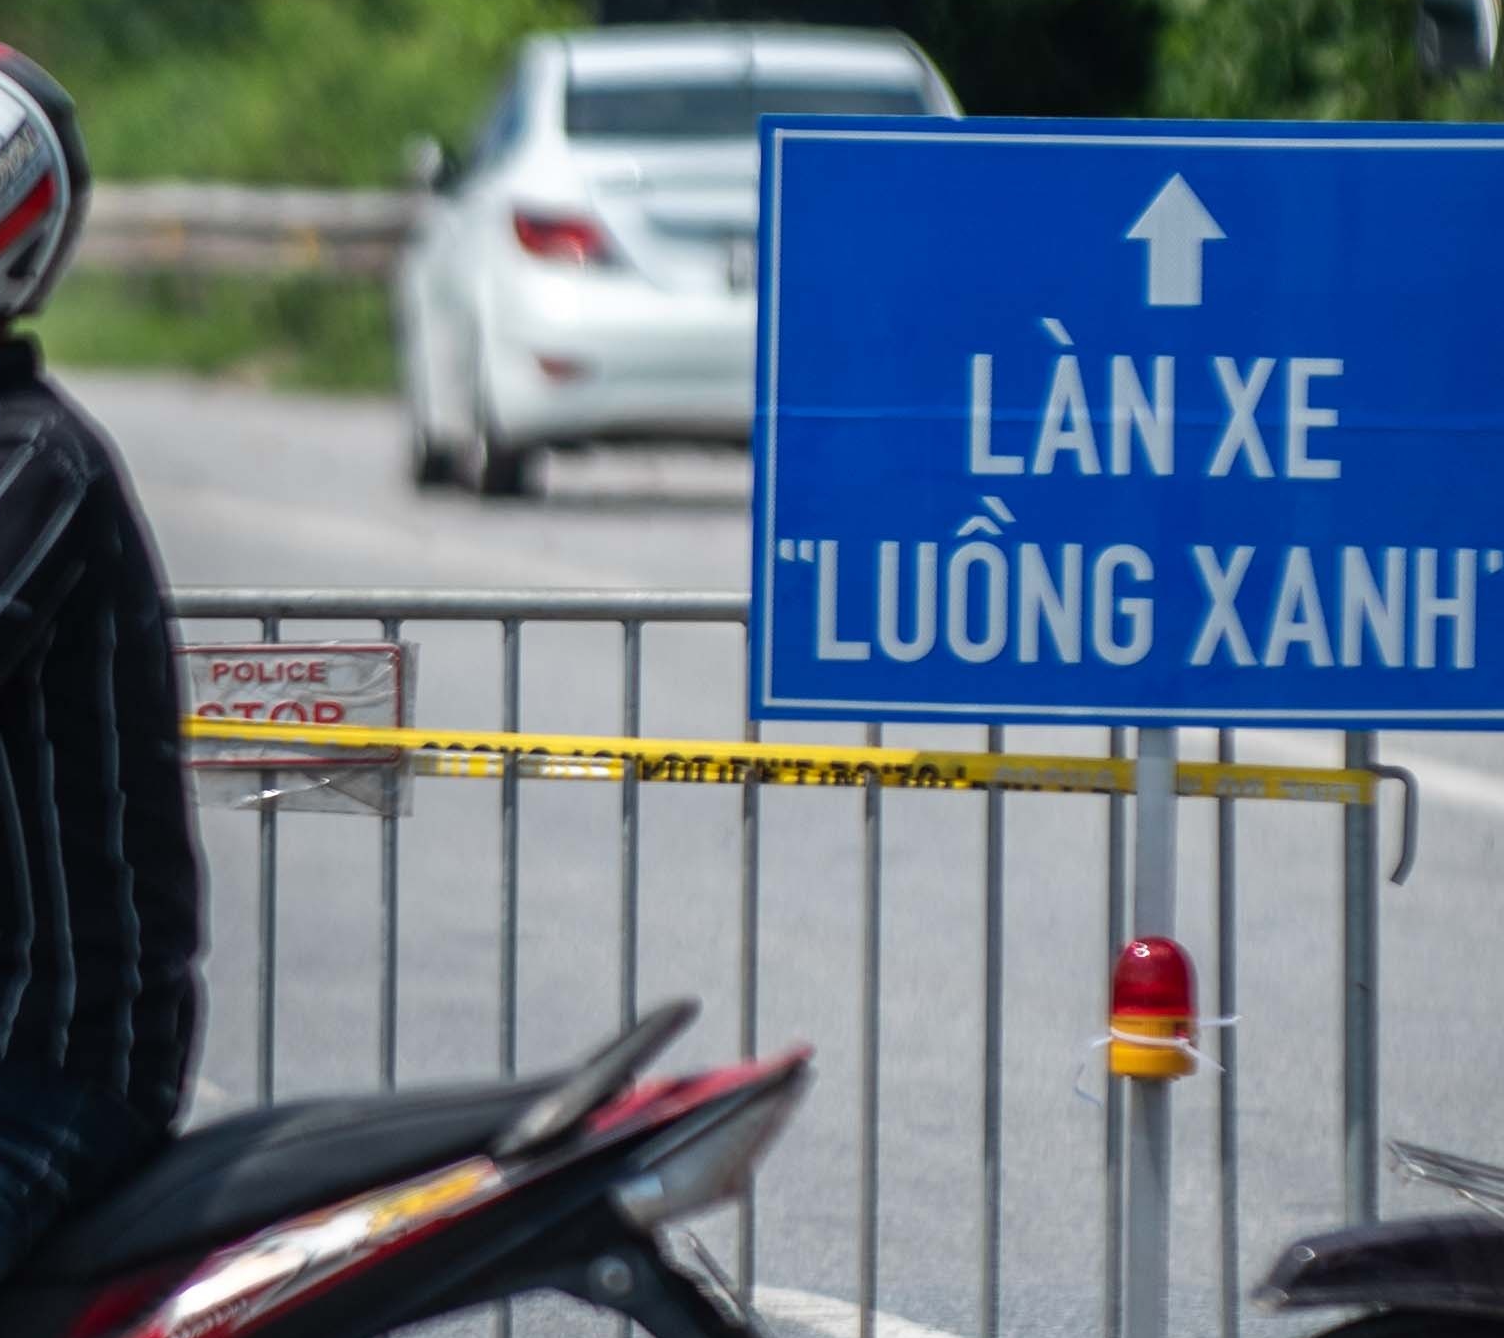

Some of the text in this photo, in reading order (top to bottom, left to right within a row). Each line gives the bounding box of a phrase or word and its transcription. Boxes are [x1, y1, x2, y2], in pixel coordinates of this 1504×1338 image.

[969, 317, 1345, 480] LÀN XE
[212, 661, 326, 684] POLICE
